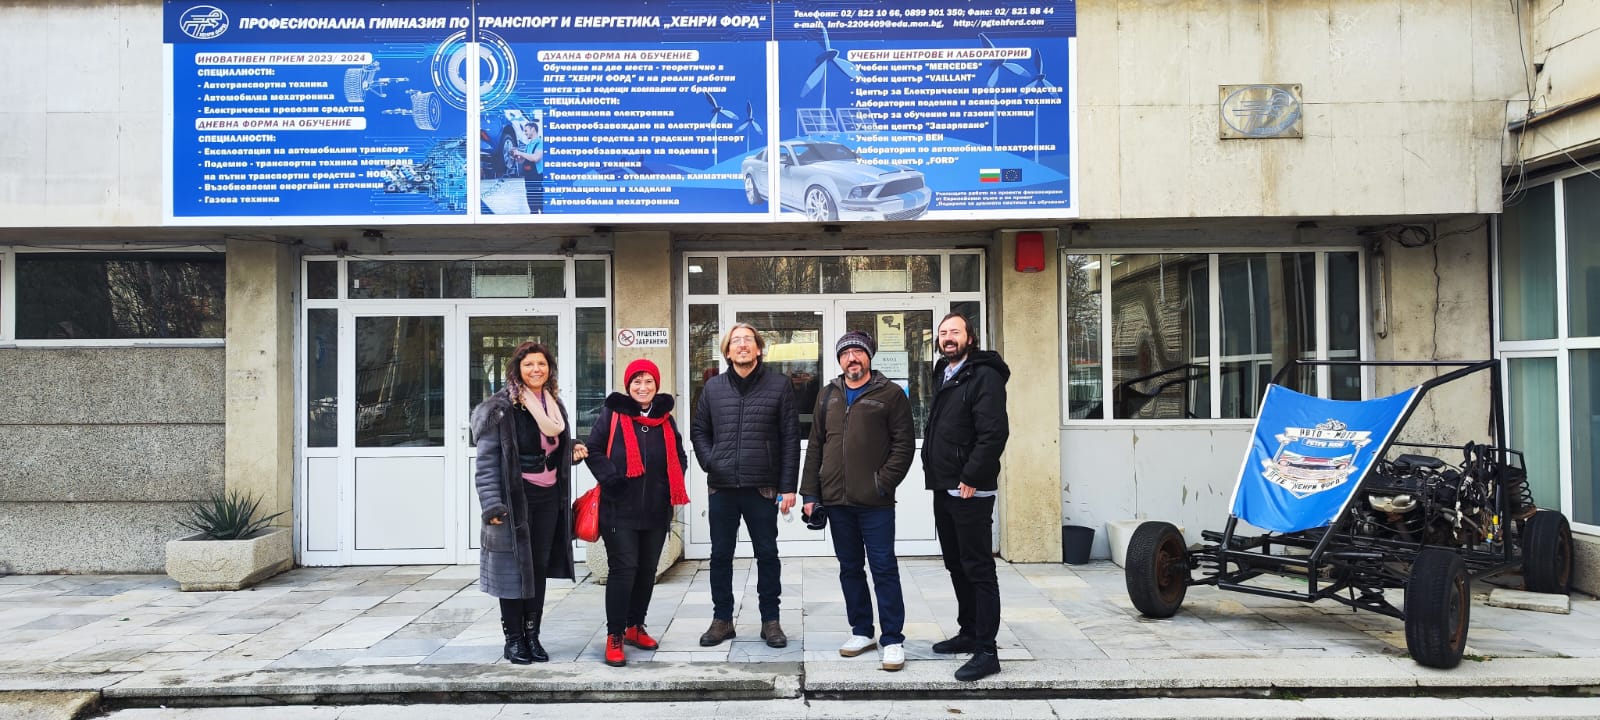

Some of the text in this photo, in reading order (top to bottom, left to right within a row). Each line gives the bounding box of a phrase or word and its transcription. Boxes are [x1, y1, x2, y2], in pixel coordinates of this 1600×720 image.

[795, 10, 838, 19] Телефони:
[841, 9, 854, 18] 02/
[877, 9, 887, 18] 10
[905, 9, 926, 18] 0899
[929, 8, 944, 17] 901
[968, 8, 992, 17] Факс:
[995, 8, 1008, 17] 02/
[1030, 7, 1040, 16] 88
[1044, 7, 1053, 16] 44
[240, 14, 765, 30] ПРОФЕСИОНАЛНА ГИМНАЗИЯ ПО ТРАНСПОРТ И ЕНЕРГЕТИКА „ХЕНРИ ФОРД“
[197, 53, 366, 64] ИНОВАТИВЕН ПРИЕМ 2023/ 2024
[543, 51, 692, 61] ДУАЛНА ФОРМА НА ОБУЧЕНИЕ
[851, 49, 1027, 60] УЧЕБНИ ЦЕНТРОВЕ И ЛАБОРАТОРИИ
[544, 63, 588, 72] Обучение
[592, 63, 603, 72] на
[605, 63, 622, 72] две
[625, 63, 653, 72] места
[662, 63, 715, 72] теоретично
[718, 63, 723, 72] в
[855, 62, 982, 72] Учебен център "MERCEDES"
[198, 69, 274, 77] СПЕЦИАЛНОСТИ:
[544, 74, 565, 83] ПГТЕ
[606, 74, 635, 83] ФОРД"
[639, 74, 644, 83] и
[647, 74, 658, 83] на
[661, 74, 694, 83] реални
[697, 74, 735, 83] работни
[856, 74, 976, 84] Учебен център "VAILLANT"
[204, 79, 327, 89] Автотранспортна техника
[544, 85, 572, 94] места
[594, 85, 628, 94] водещи
[631, 84, 676, 94] компании
[679, 84, 688, 94] от
[856, 85, 1062, 96] Център за Електрически превозни средства
[205, 91, 334, 102] Автомобилна мехатроника
[544, 97, 619, 105] СПЕЦИАЛНОСТИ:
[918, 98, 957, 107] подемна
[960, 98, 965, 106] и
[969, 98, 1022, 106] асансьорна
[1025, 97, 1061, 105] техника
[204, 103, 364, 115] Електрически превозни средства
[550, 109, 673, 118] Промишлена електроника
[855, 109, 1034, 120] Център за обучение на газови техници
[198, 119, 352, 128] ДНЕВНА ФОРМА НА ОБУЧЕНИЕ
[550, 121, 732, 130] Електрообзавеждане на електрически
[855, 122, 888, 131] Учебен
[891, 122, 922, 131] център
[199, 134, 275, 142] СПЕЦИАЛНОСТИ:
[544, 135, 589, 143] превозни
[592, 135, 634, 143] средства
[638, 135, 648, 143] за
[697, 134, 743, 143] транспорт
[856, 133, 943, 143] Учебен център ВЕИ
[274, 147, 285, 156] на
[361, 146, 408, 155] транспорт
[550, 147, 717, 156] Електрообзавеждане на подемна и
[918, 145, 929, 154] по
[932, 144, 991, 154] автомобилна
[995, 143, 1055, 153] мехатроника
[205, 160, 247, 168] Подемно
[257, 159, 316, 168] транспортна
[320, 159, 357, 167] техника
[361, 158, 414, 167] монтирана
[545, 159, 641, 169] асансьорна техника
[855, 157, 889, 166] Учебен
[891, 157, 922, 166] център
[204, 173, 215, 181] на
[219, 173, 246, 181] пътни
[249, 172, 309, 180] транспортни
[313, 171, 355, 180] средства
[551, 173, 614, 181] Топлотехника
[334, 180, 384, 190] източници
[545, 184, 671, 194] вентилационна и хладилна
[205, 195, 279, 204] Газова техника
[551, 197, 679, 206] Автомобилна мехатроника
[1300, 430, 1323, 438] АВТО
[1334, 431, 1358, 440] МОТО
[1269, 470, 1288, 485] ПГТЕ
